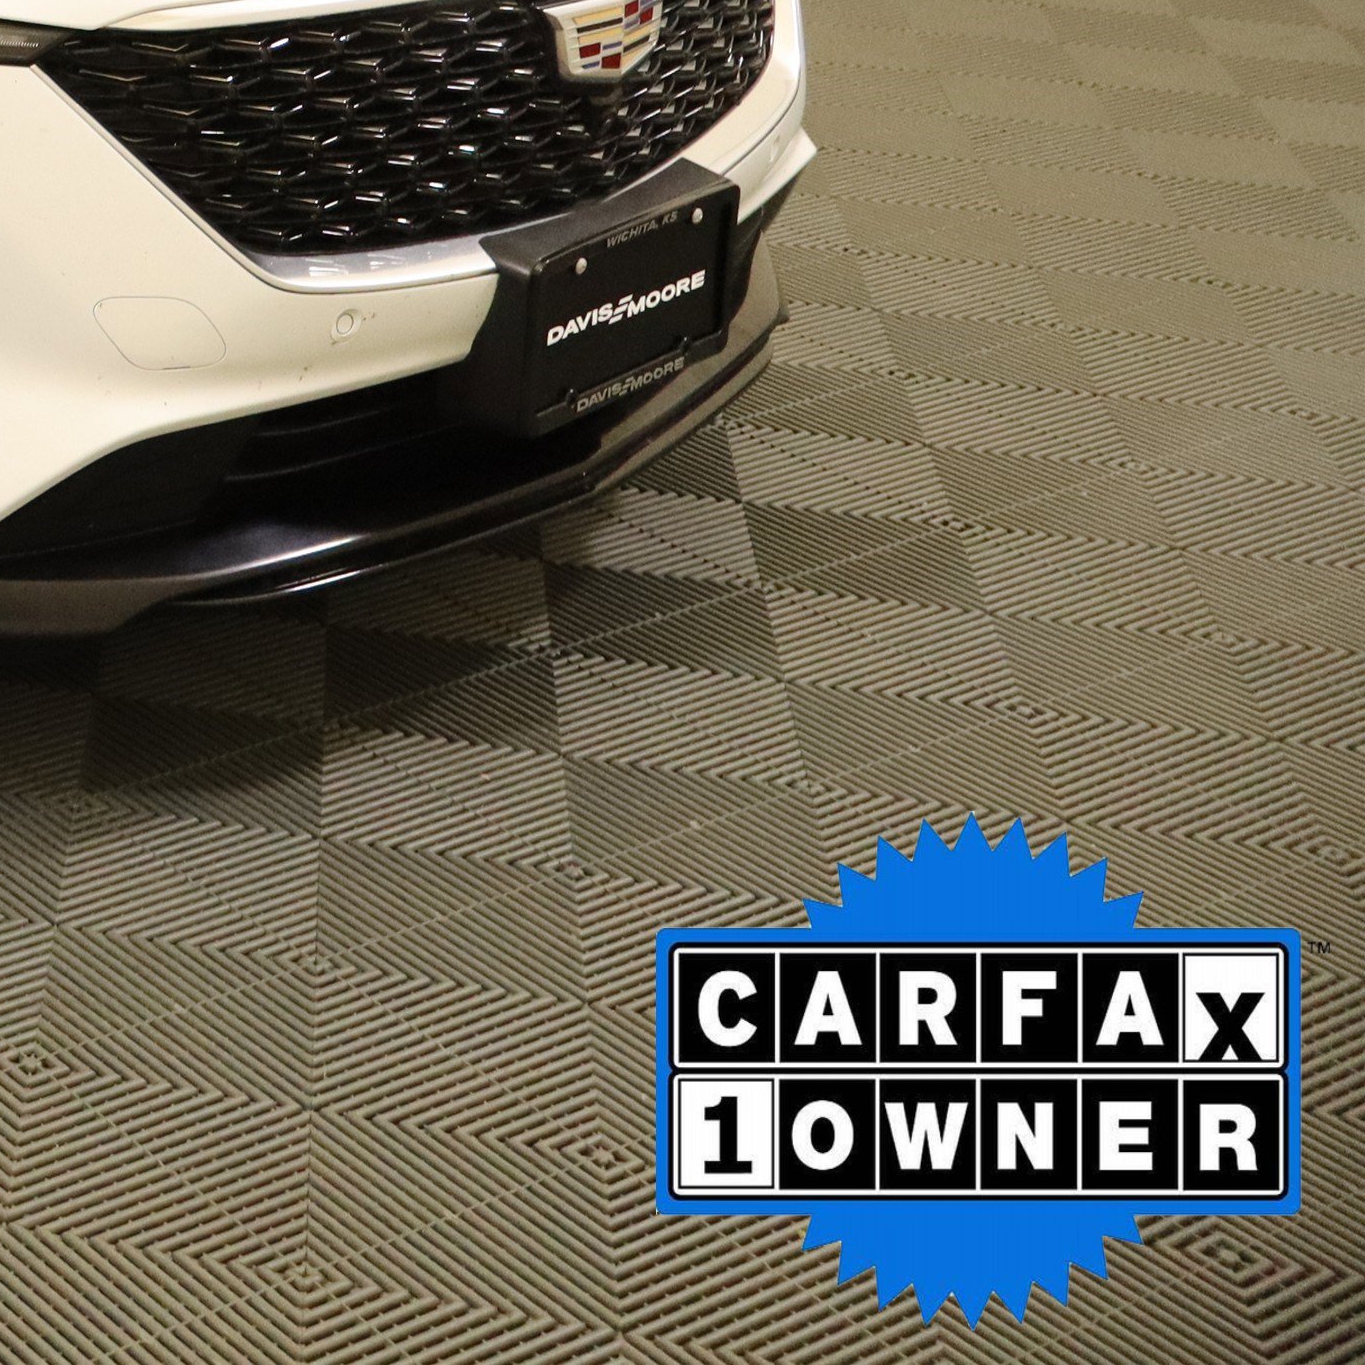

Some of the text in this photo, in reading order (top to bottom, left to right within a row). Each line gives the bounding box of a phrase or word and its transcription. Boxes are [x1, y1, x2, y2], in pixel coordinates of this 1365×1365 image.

[547, 269, 706, 346] DAVIS MOORE
[576, 357, 685, 413] DAVIS MOORE
